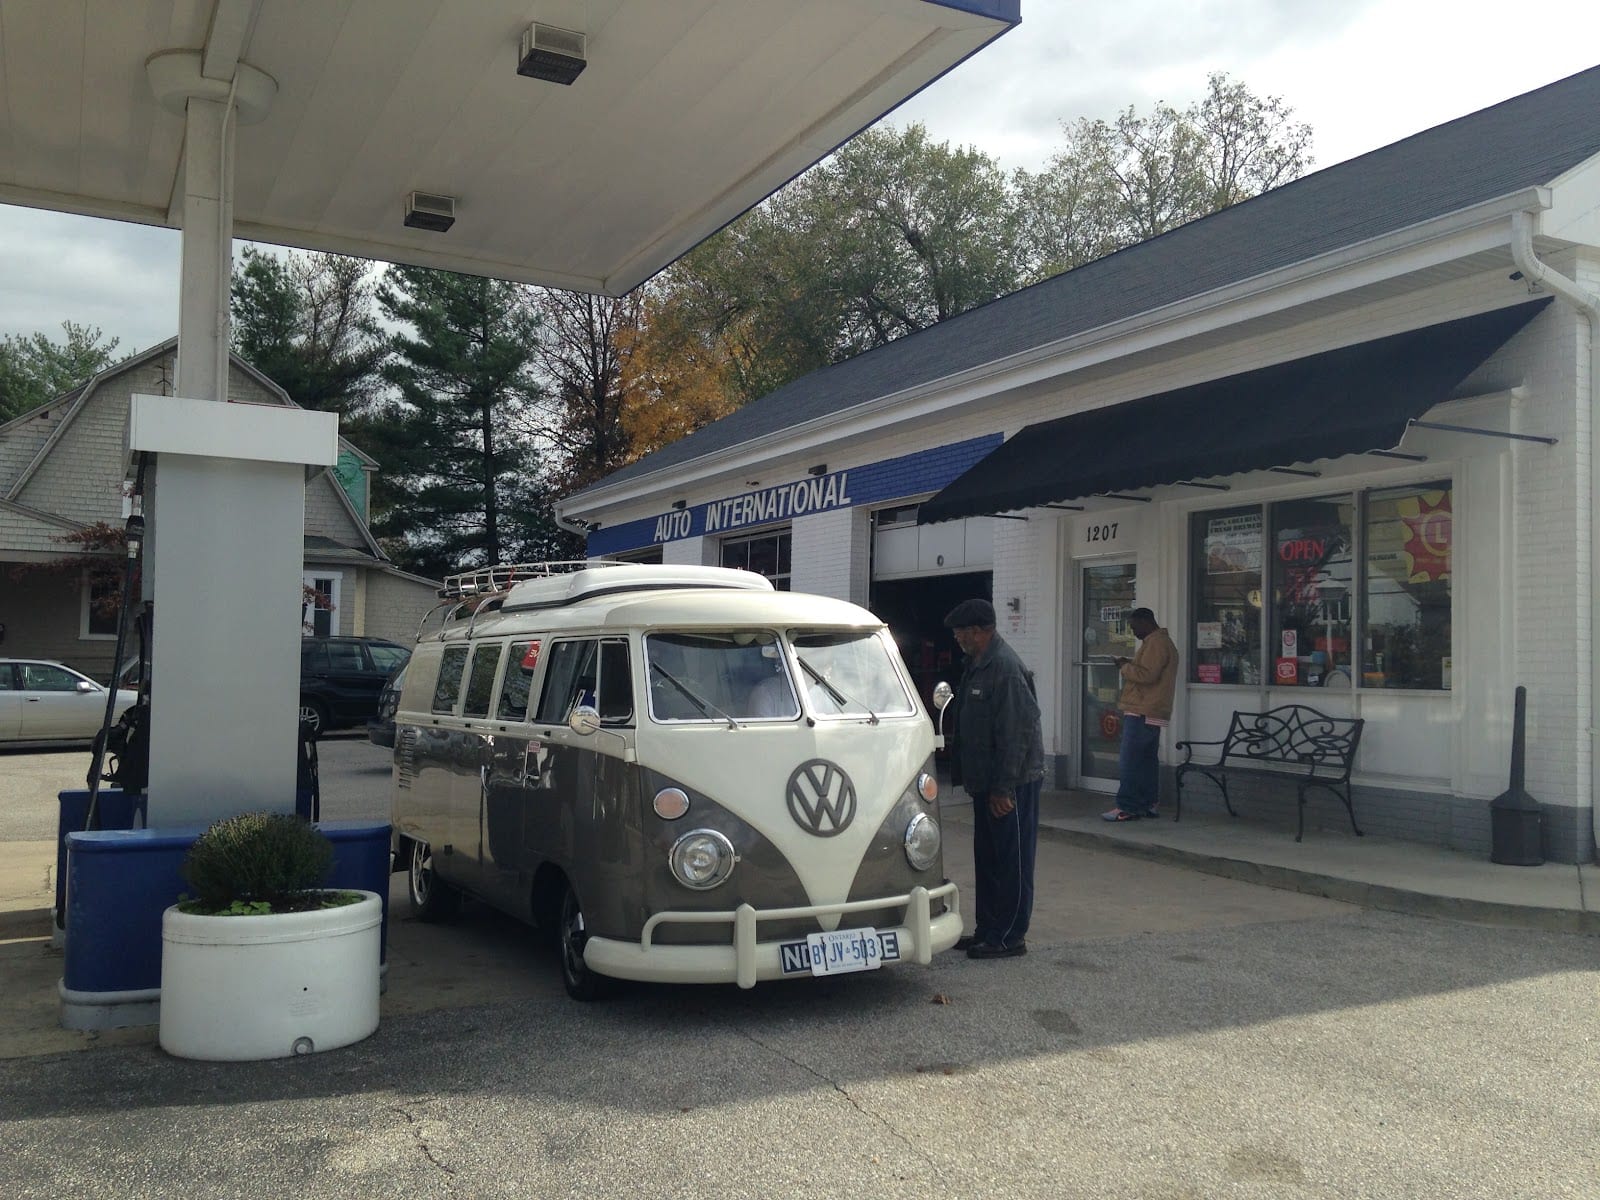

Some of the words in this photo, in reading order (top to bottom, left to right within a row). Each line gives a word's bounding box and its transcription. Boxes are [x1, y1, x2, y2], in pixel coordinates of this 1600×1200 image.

[653, 509, 692, 542] AUTO
[705, 473, 851, 532] INTERNATIONAL
[1087, 522, 1118, 542] 1207
[1280, 539, 1325, 561] OPEN
[1103, 607, 1120, 620] OPEN
[786, 758, 857, 838] VW
